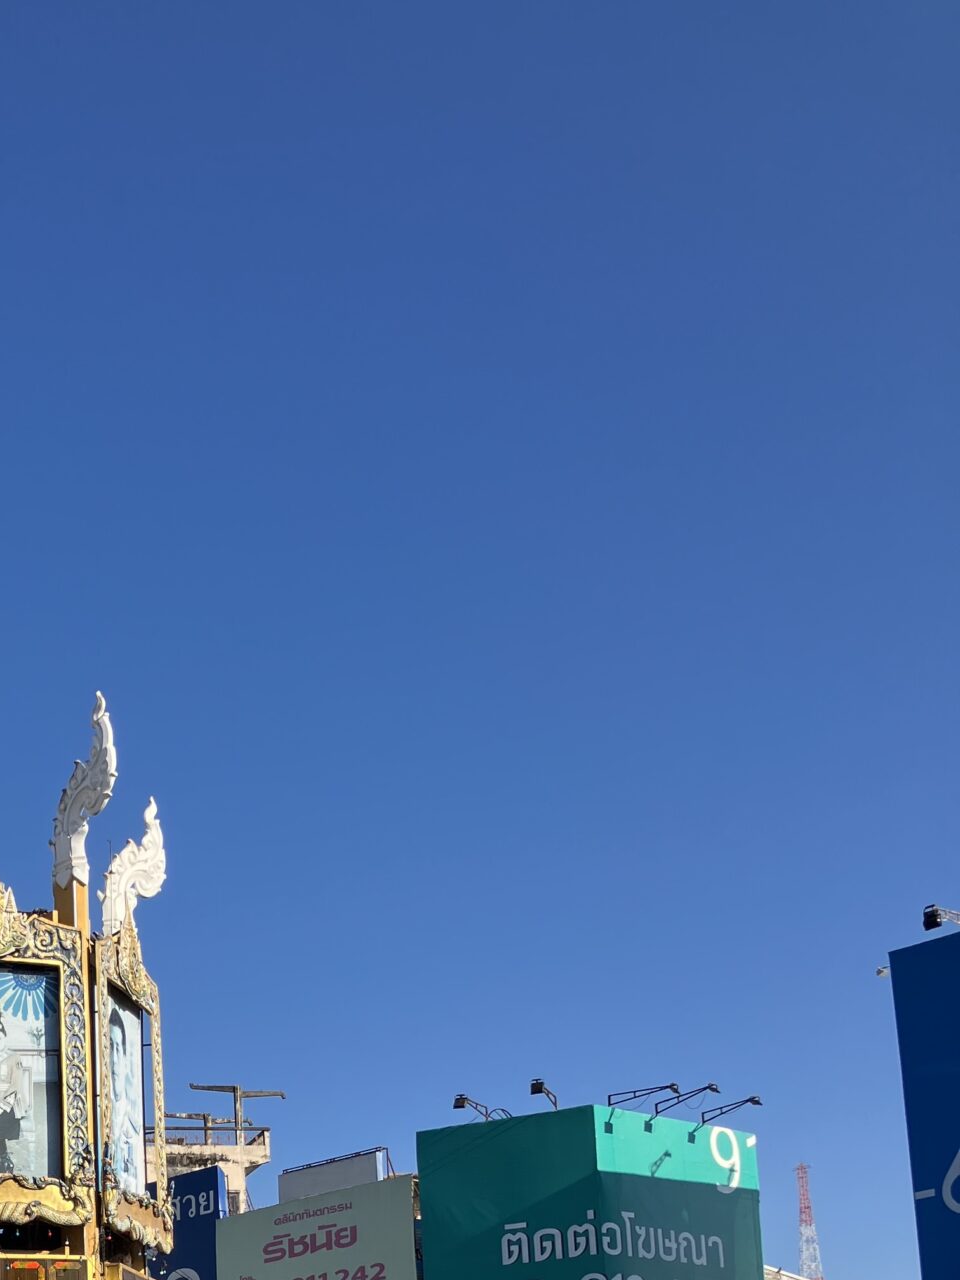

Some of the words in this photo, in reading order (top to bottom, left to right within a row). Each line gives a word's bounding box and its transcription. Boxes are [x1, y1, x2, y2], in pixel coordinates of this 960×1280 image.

[500, 1209, 725, 1267] ติดต่อโฆษณา
